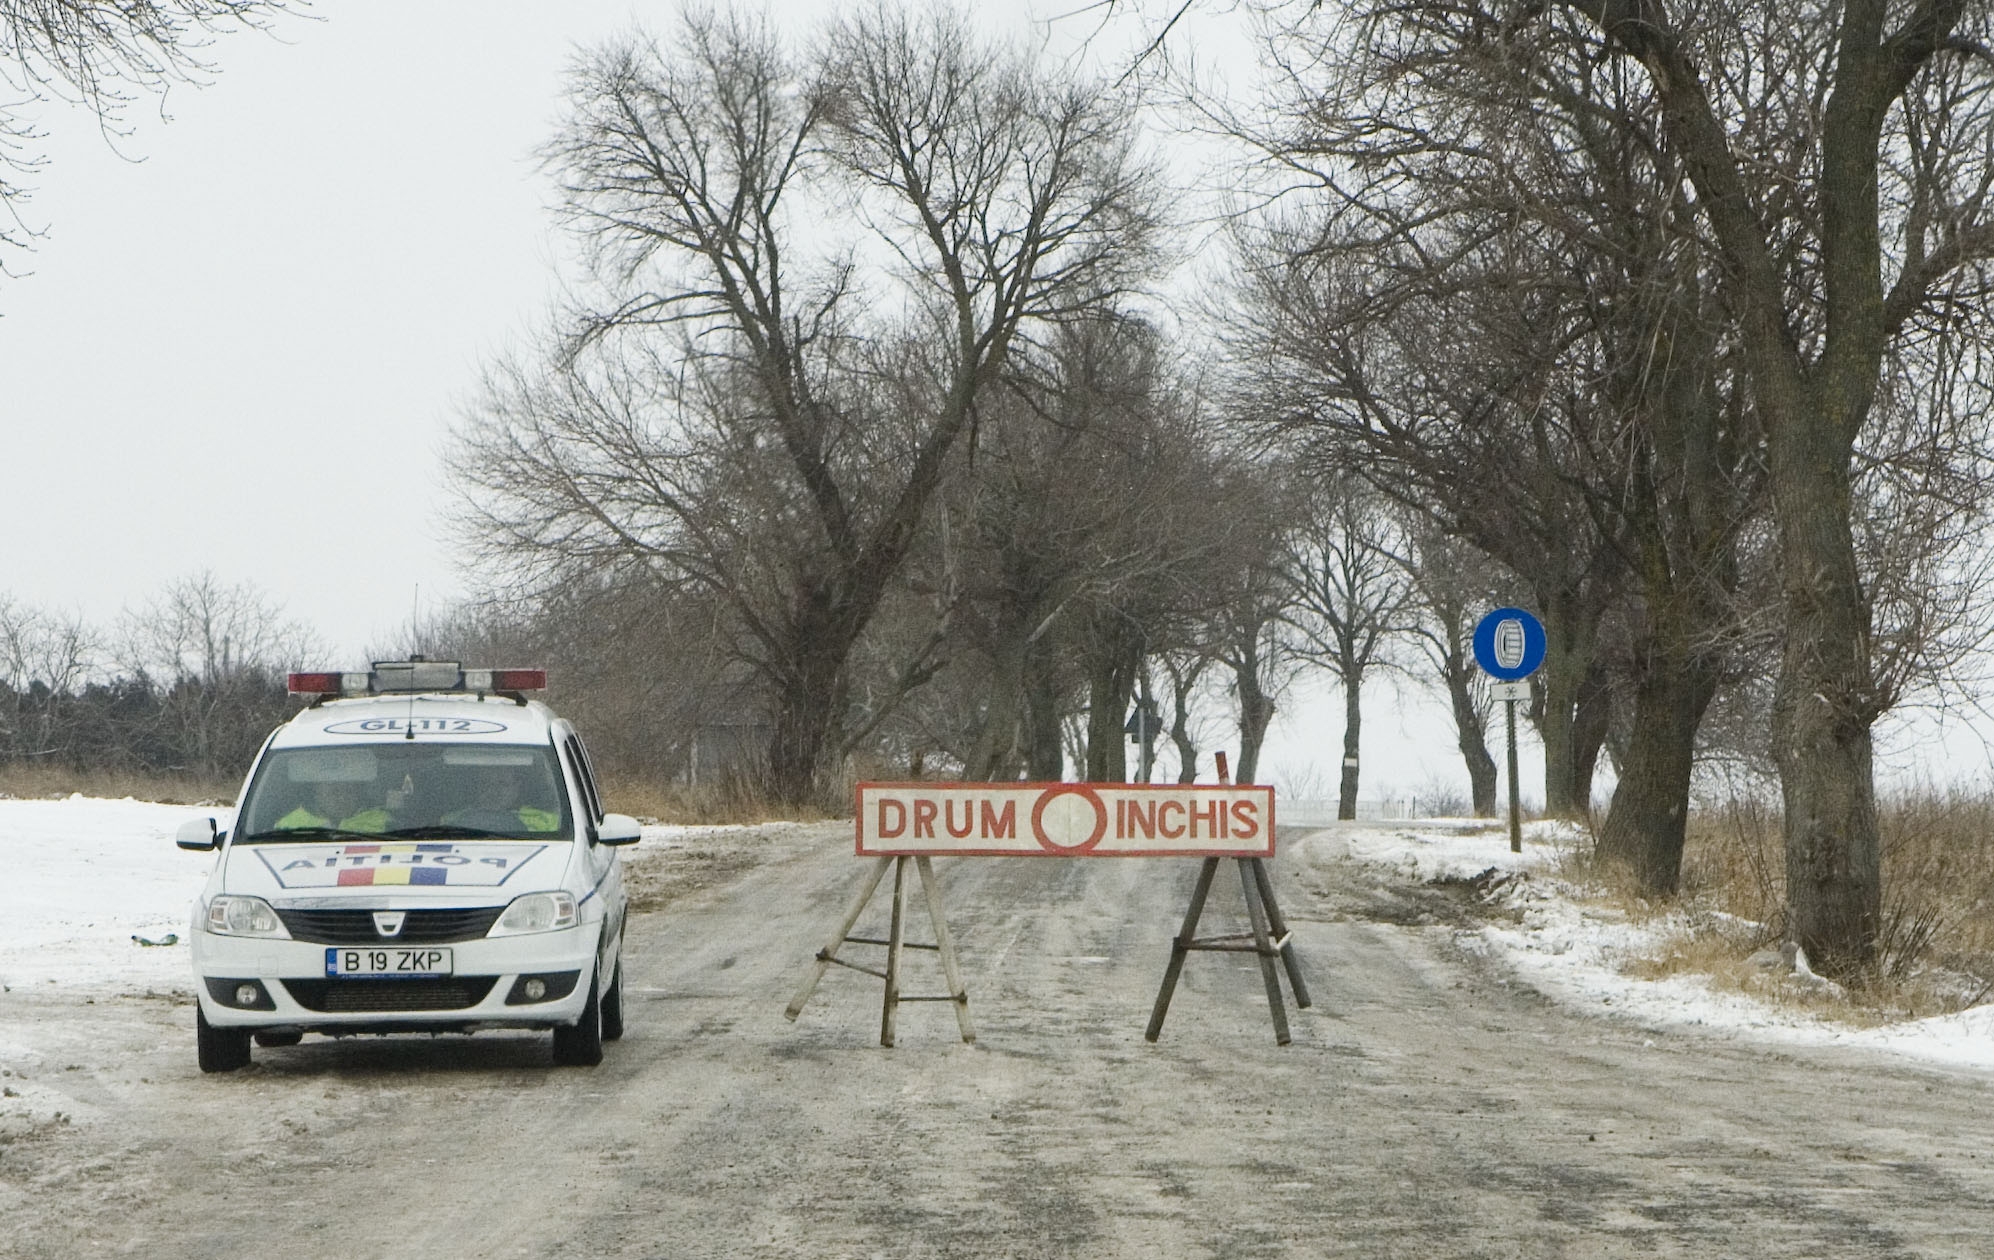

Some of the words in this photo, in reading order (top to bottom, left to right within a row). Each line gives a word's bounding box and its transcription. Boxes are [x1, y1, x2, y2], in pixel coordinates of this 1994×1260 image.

[360, 719, 471, 731] GL-112
[877, 798, 1017, 839] DRUM
[1115, 799, 1259, 840] INCHIS
[344, 951, 360, 971] B
[368, 951, 387, 971] 19
[396, 951, 442, 971] ZKP
